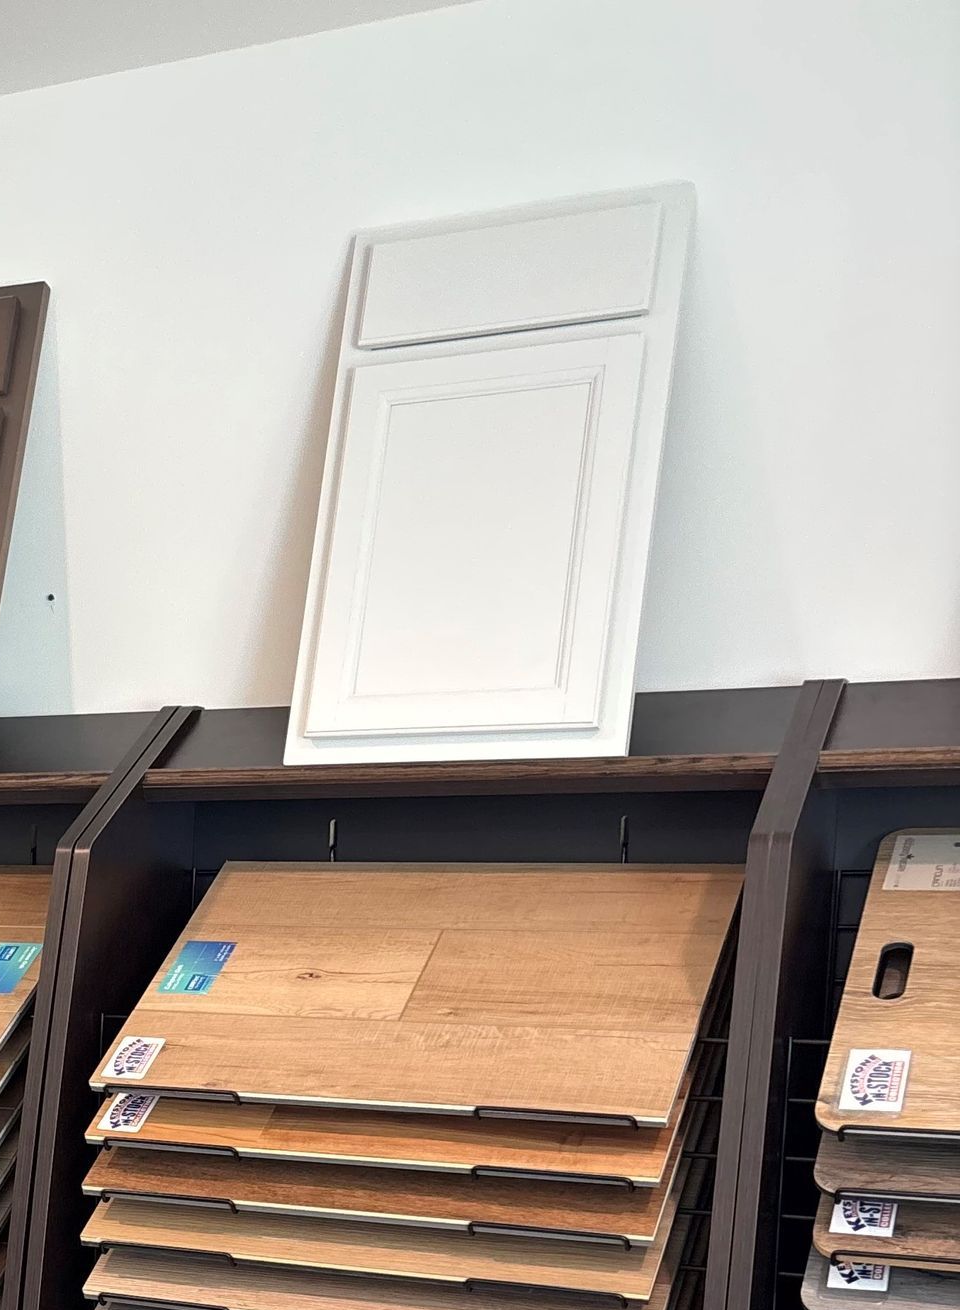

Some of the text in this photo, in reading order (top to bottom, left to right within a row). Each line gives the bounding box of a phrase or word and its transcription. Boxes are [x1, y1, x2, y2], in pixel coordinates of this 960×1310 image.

[113, 1038, 142, 1075] KEYSTONE
[126, 1042, 150, 1072] IN-STOCK
[850, 1054, 877, 1106] KEYSTONE
[867, 1061, 893, 1101] IN-STOCK
[887, 1060, 904, 1101] COLLECTION
[109, 1093, 133, 1128] KEYSTON
[122, 1095, 147, 1125] IN-STOCK
[842, 1201, 866, 1231] KEYS
[858, 1201, 881, 1227] IN-ST
